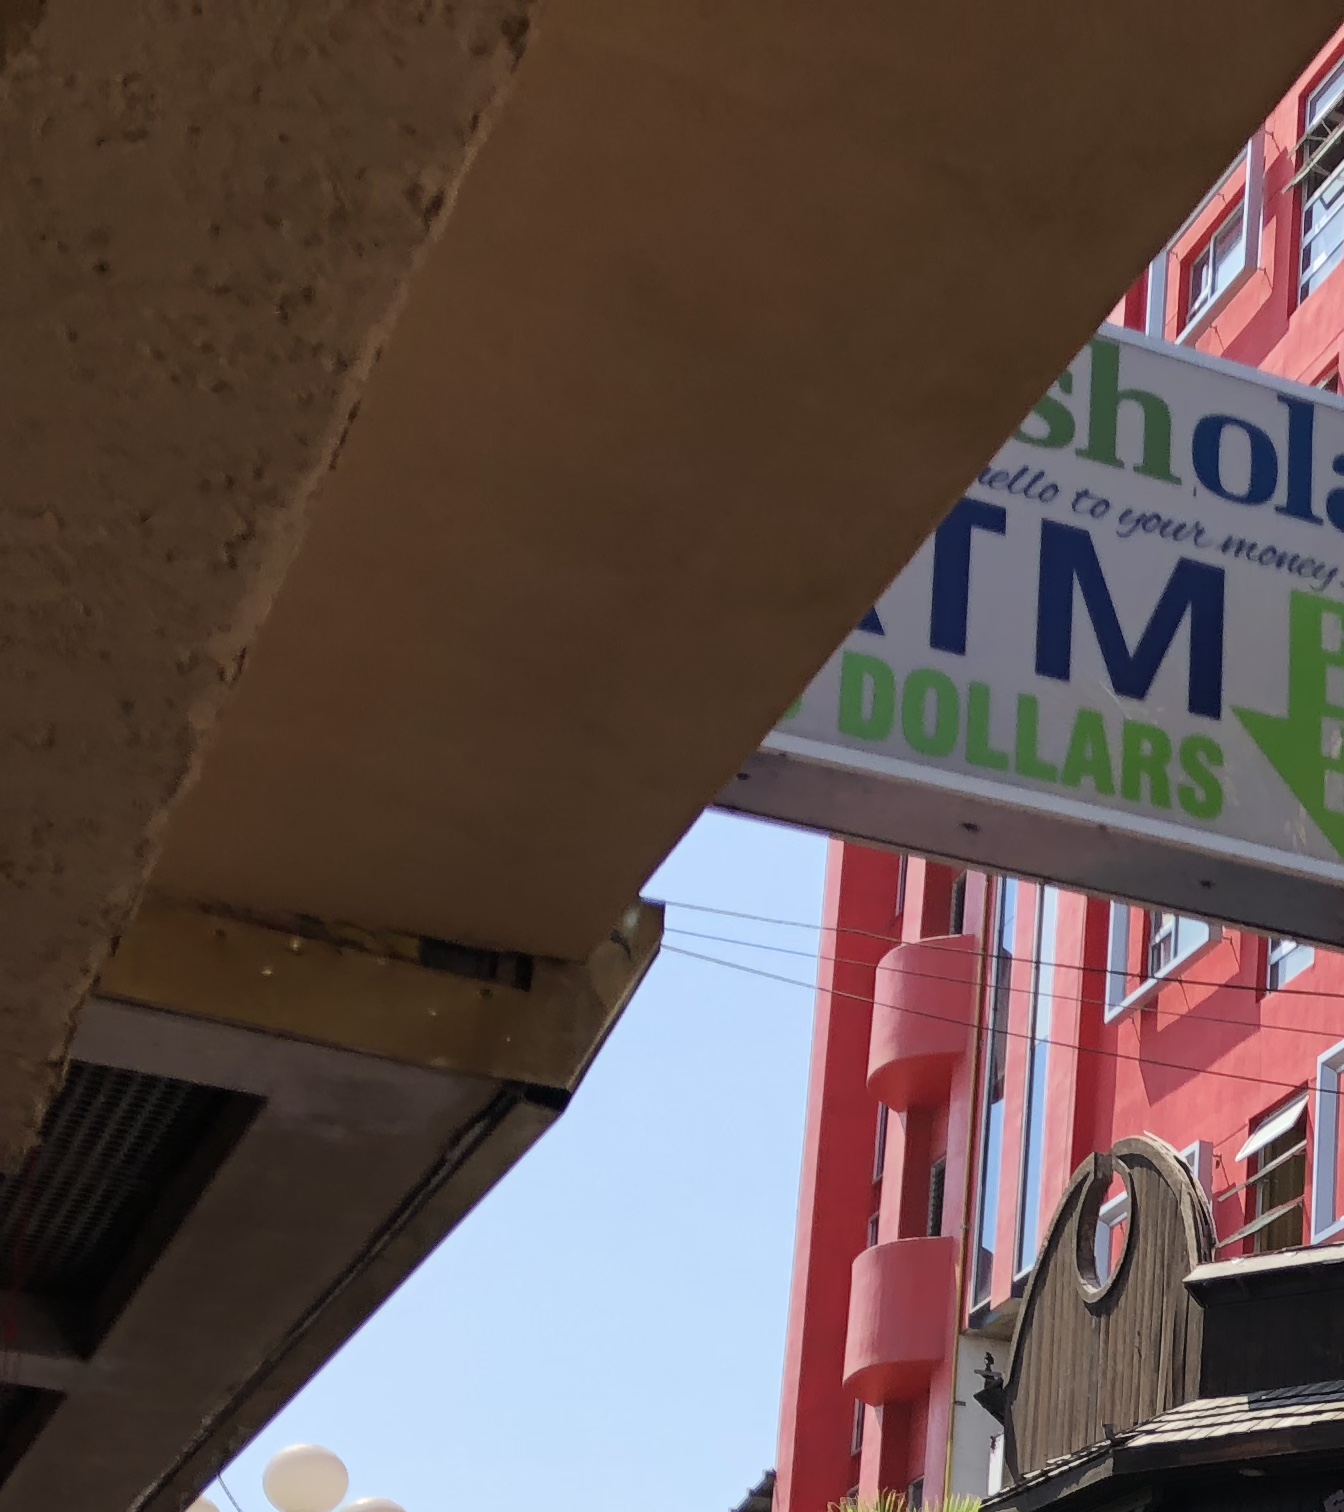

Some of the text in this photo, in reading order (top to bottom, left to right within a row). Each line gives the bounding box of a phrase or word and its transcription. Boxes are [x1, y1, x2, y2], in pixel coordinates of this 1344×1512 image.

[1070, 487, 1110, 519] to
[1117, 507, 1208, 548] your
[858, 497, 1226, 721] TM
[837, 650, 1225, 820] DOLLARS
